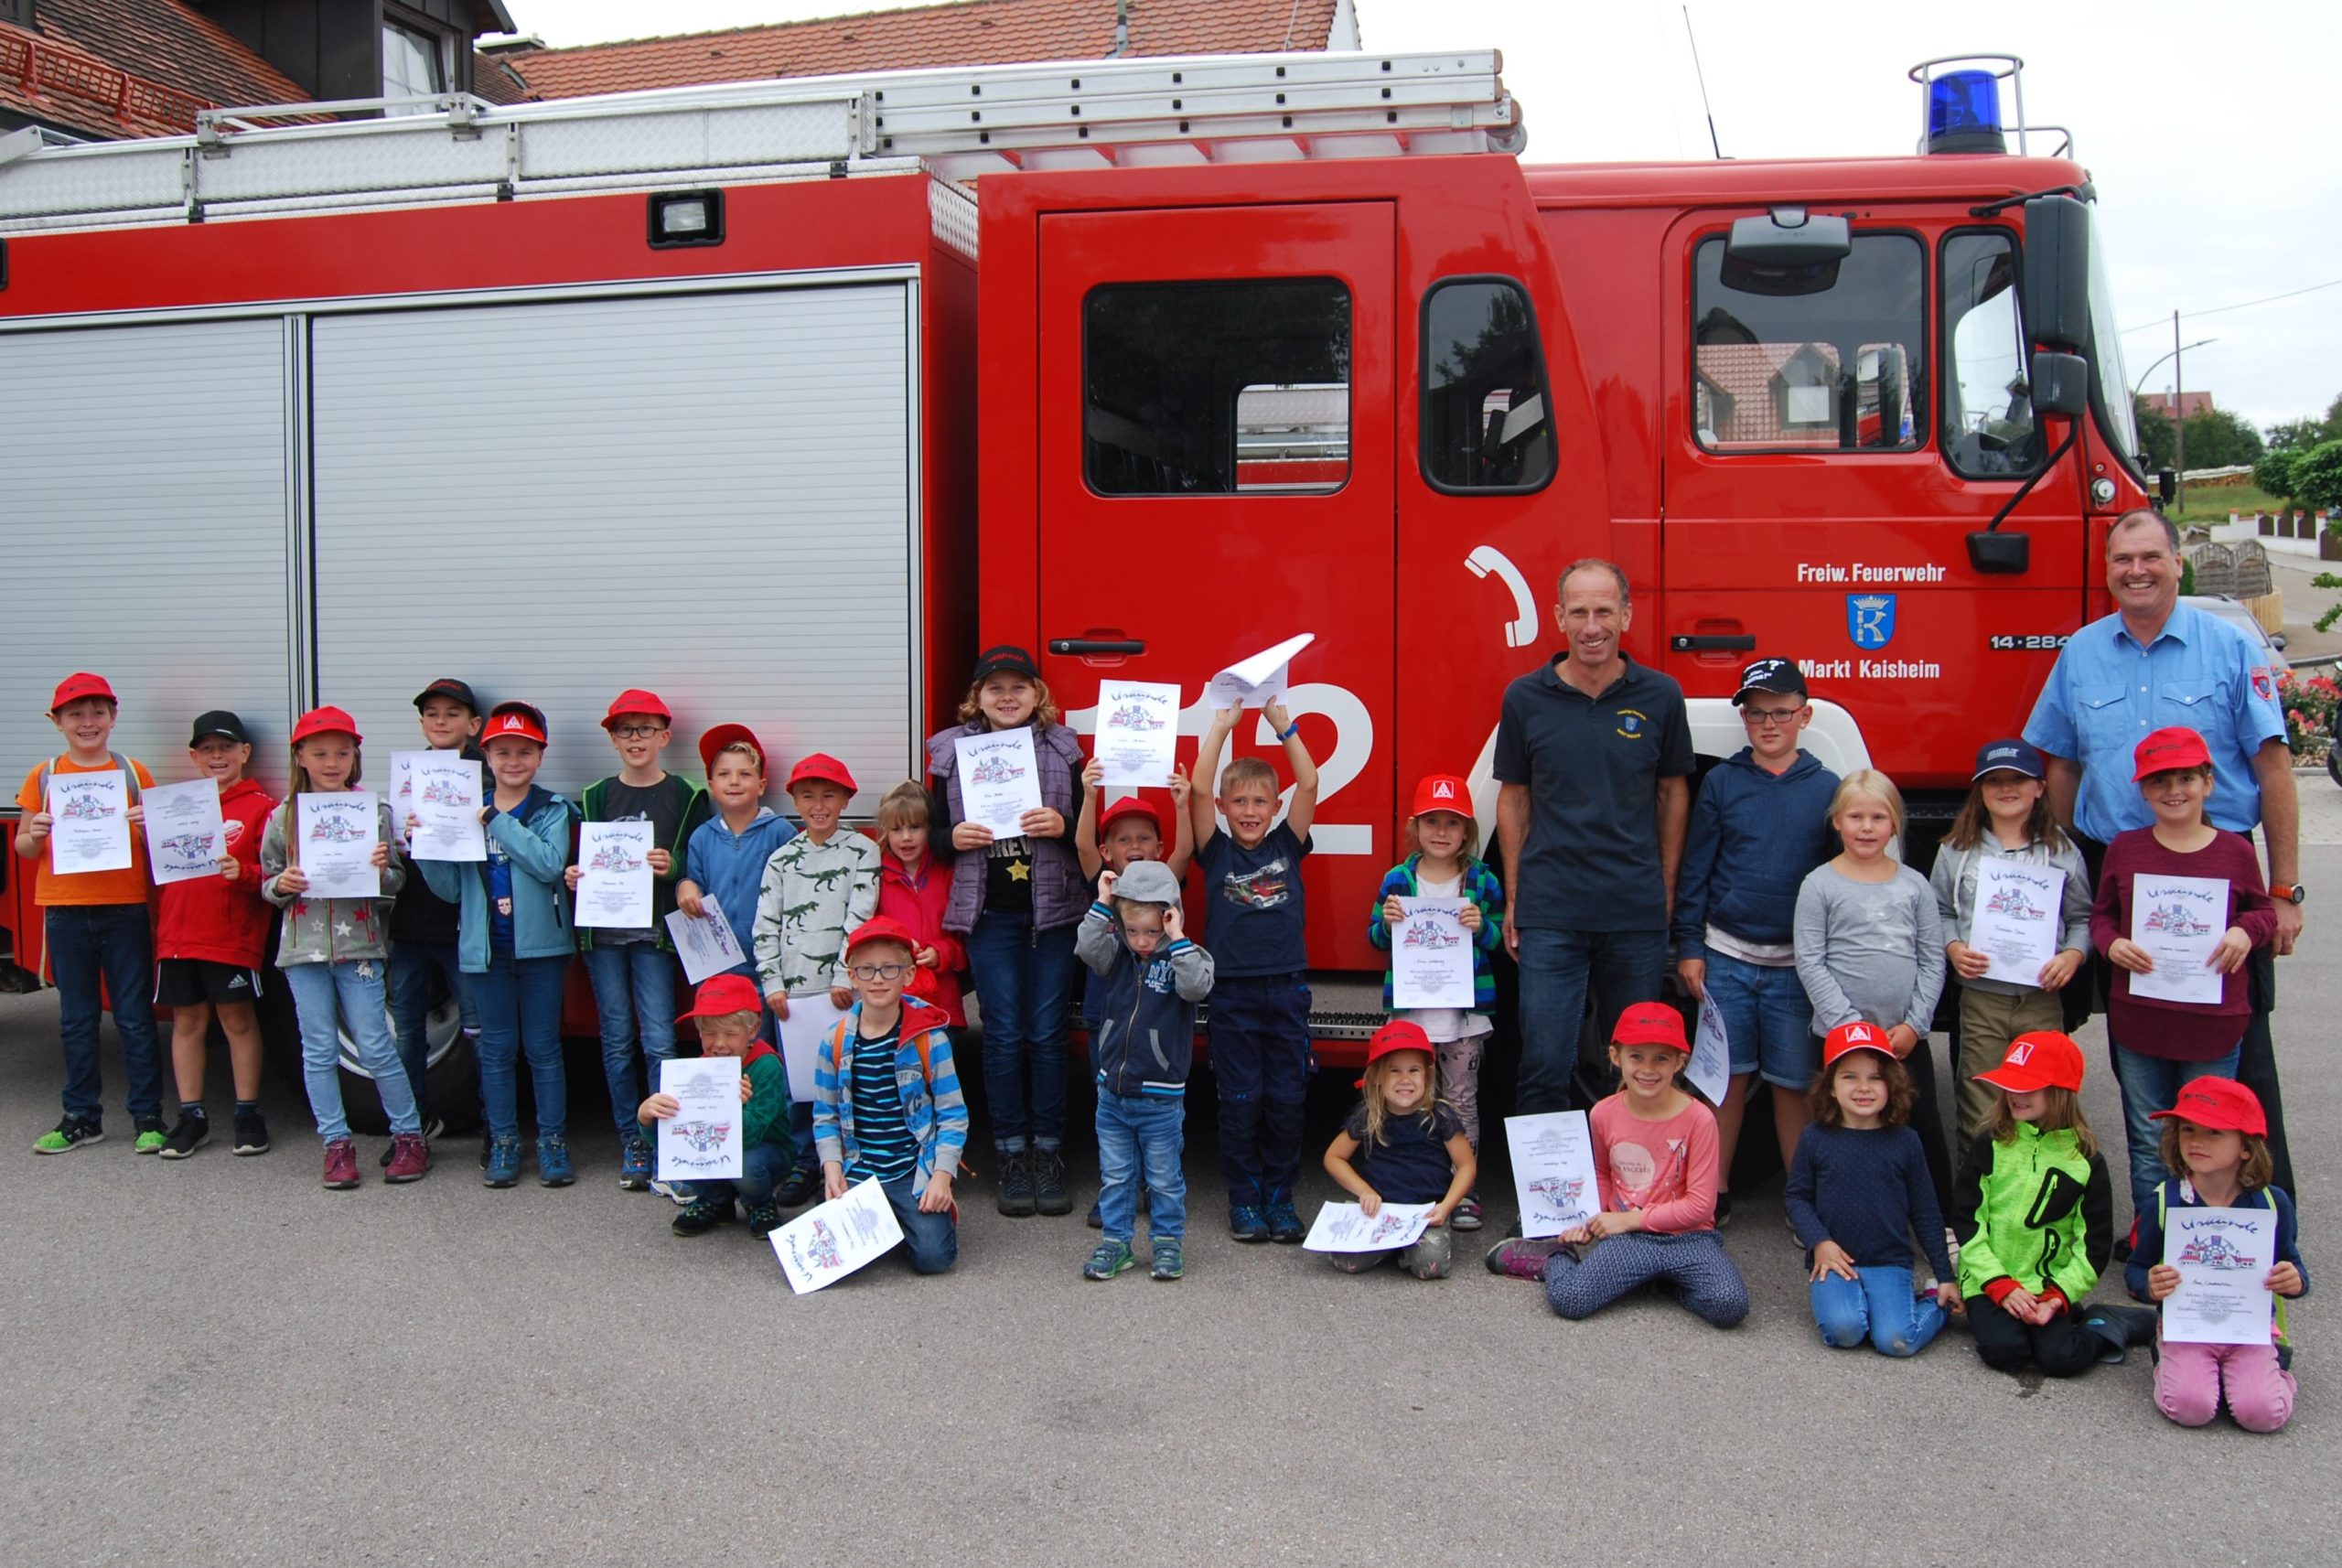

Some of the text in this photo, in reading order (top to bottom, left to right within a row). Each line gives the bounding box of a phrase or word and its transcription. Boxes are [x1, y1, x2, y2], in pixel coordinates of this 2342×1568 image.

[1798, 563, 1946, 583] Freiw. Feuerwehr
[1798, 659, 1851, 679] Markt
[1859, 659, 1940, 679] Kaisheim
